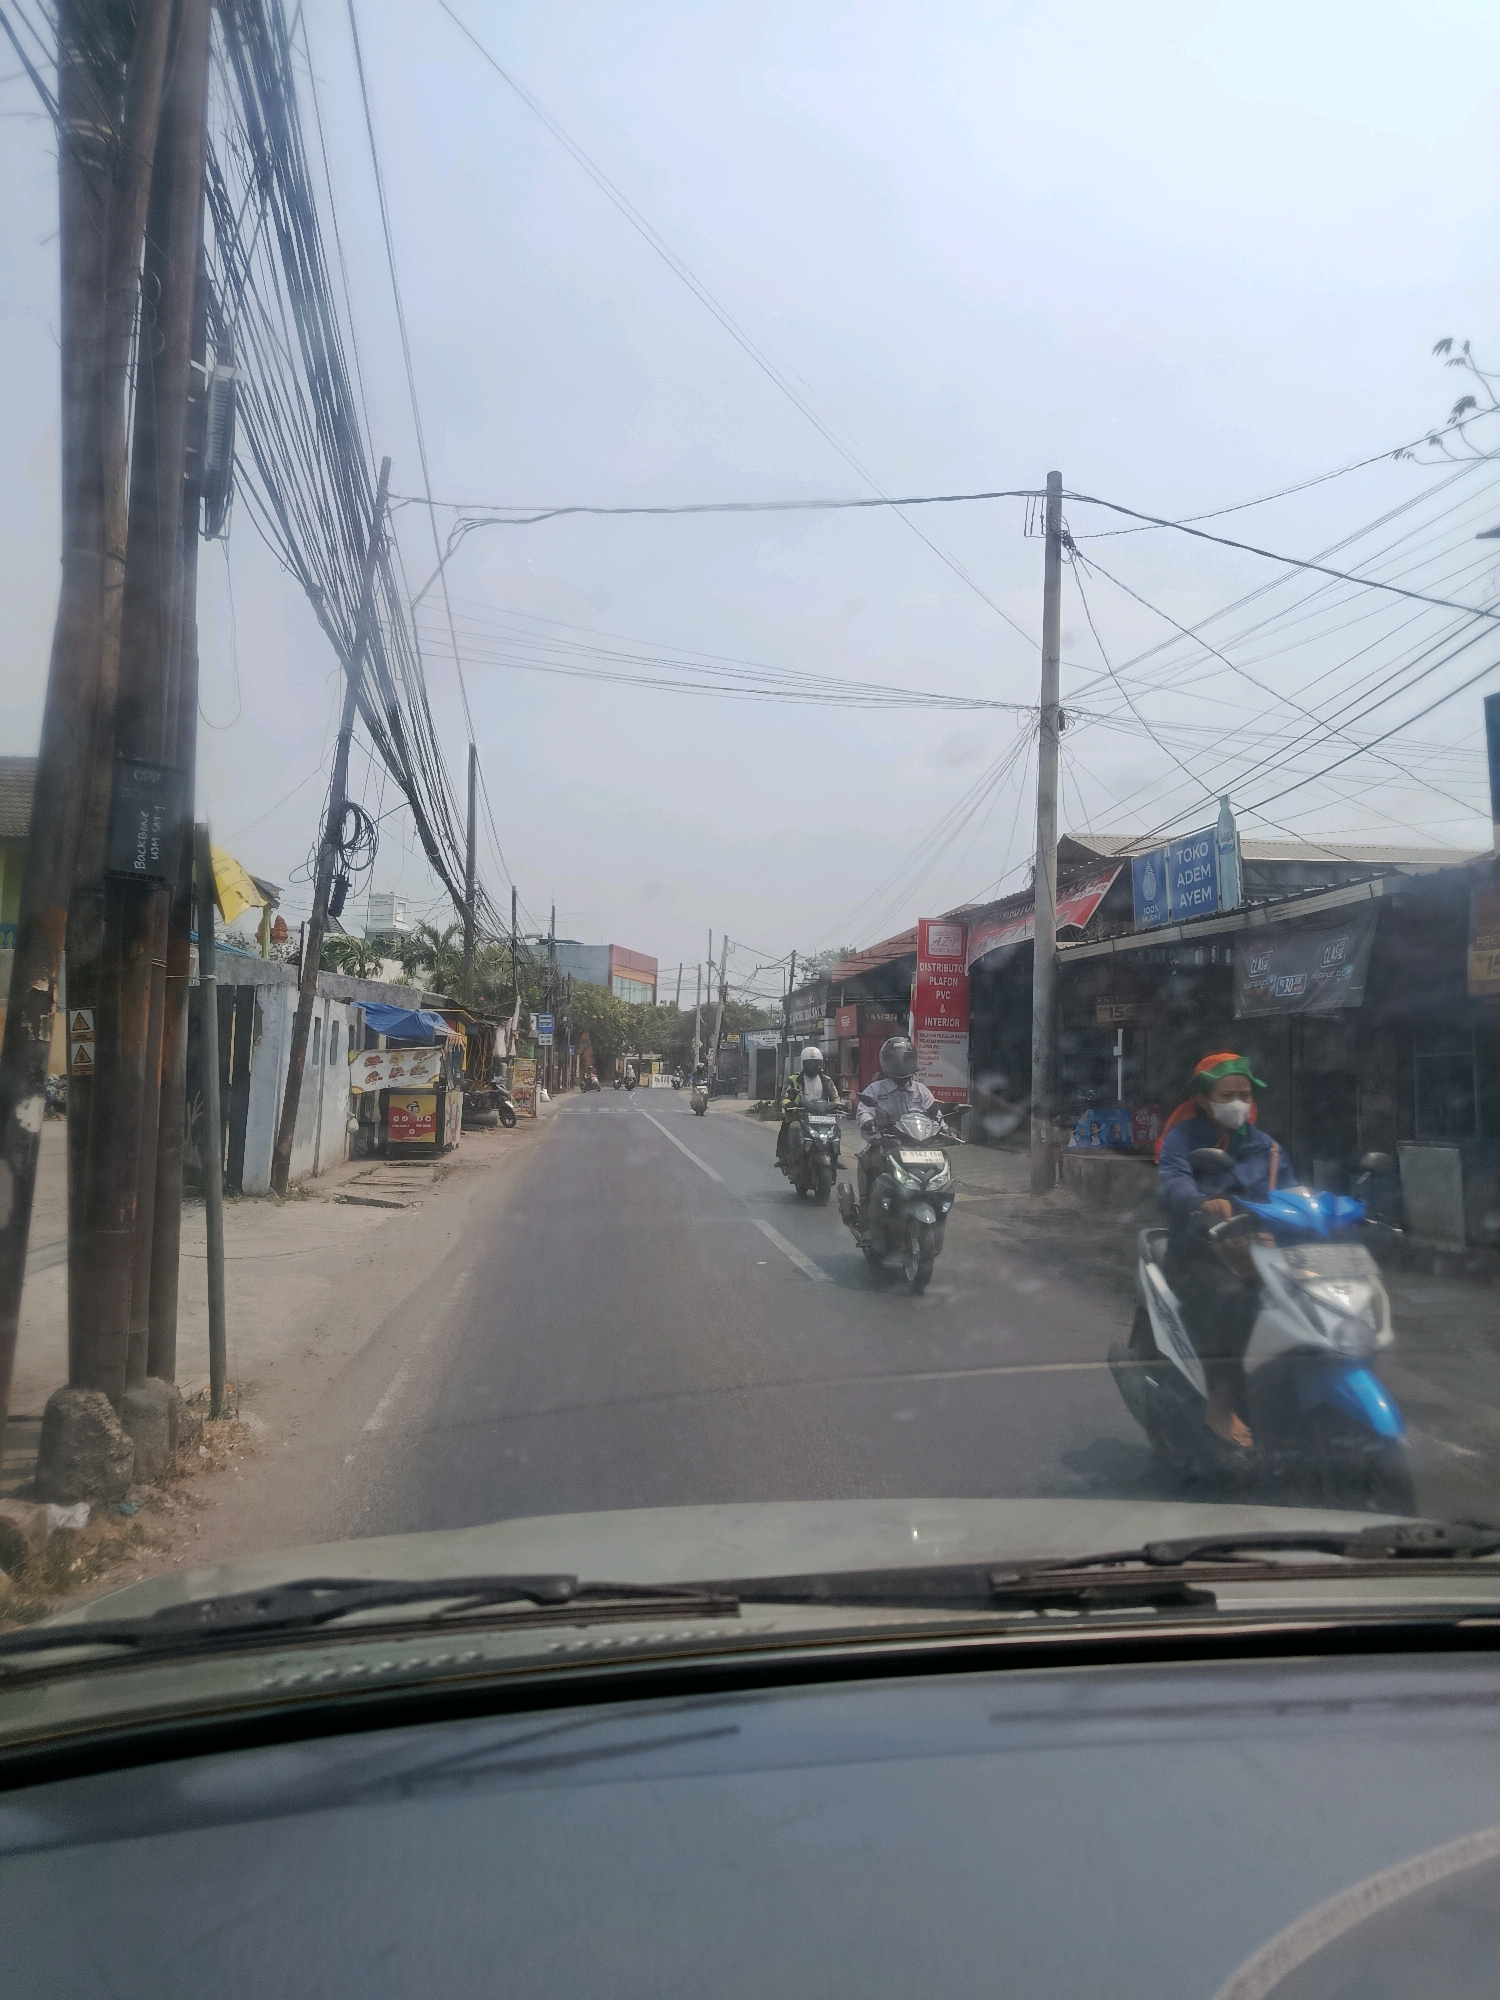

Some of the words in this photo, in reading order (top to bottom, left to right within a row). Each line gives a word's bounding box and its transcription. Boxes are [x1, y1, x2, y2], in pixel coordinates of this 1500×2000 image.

[1176, 841, 1209, 865] TOKO
[1176, 862, 1212, 888] ADEM
[1179, 885, 1212, 909] AYEM
[919, 962, 966, 974] DISTRIBUTO
[929, 976, 958, 987] PLAFON
[935, 989, 951, 1000] PVC
[939, 1003, 946, 1014] &
[924, 1016, 960, 1028] INTERIOR
